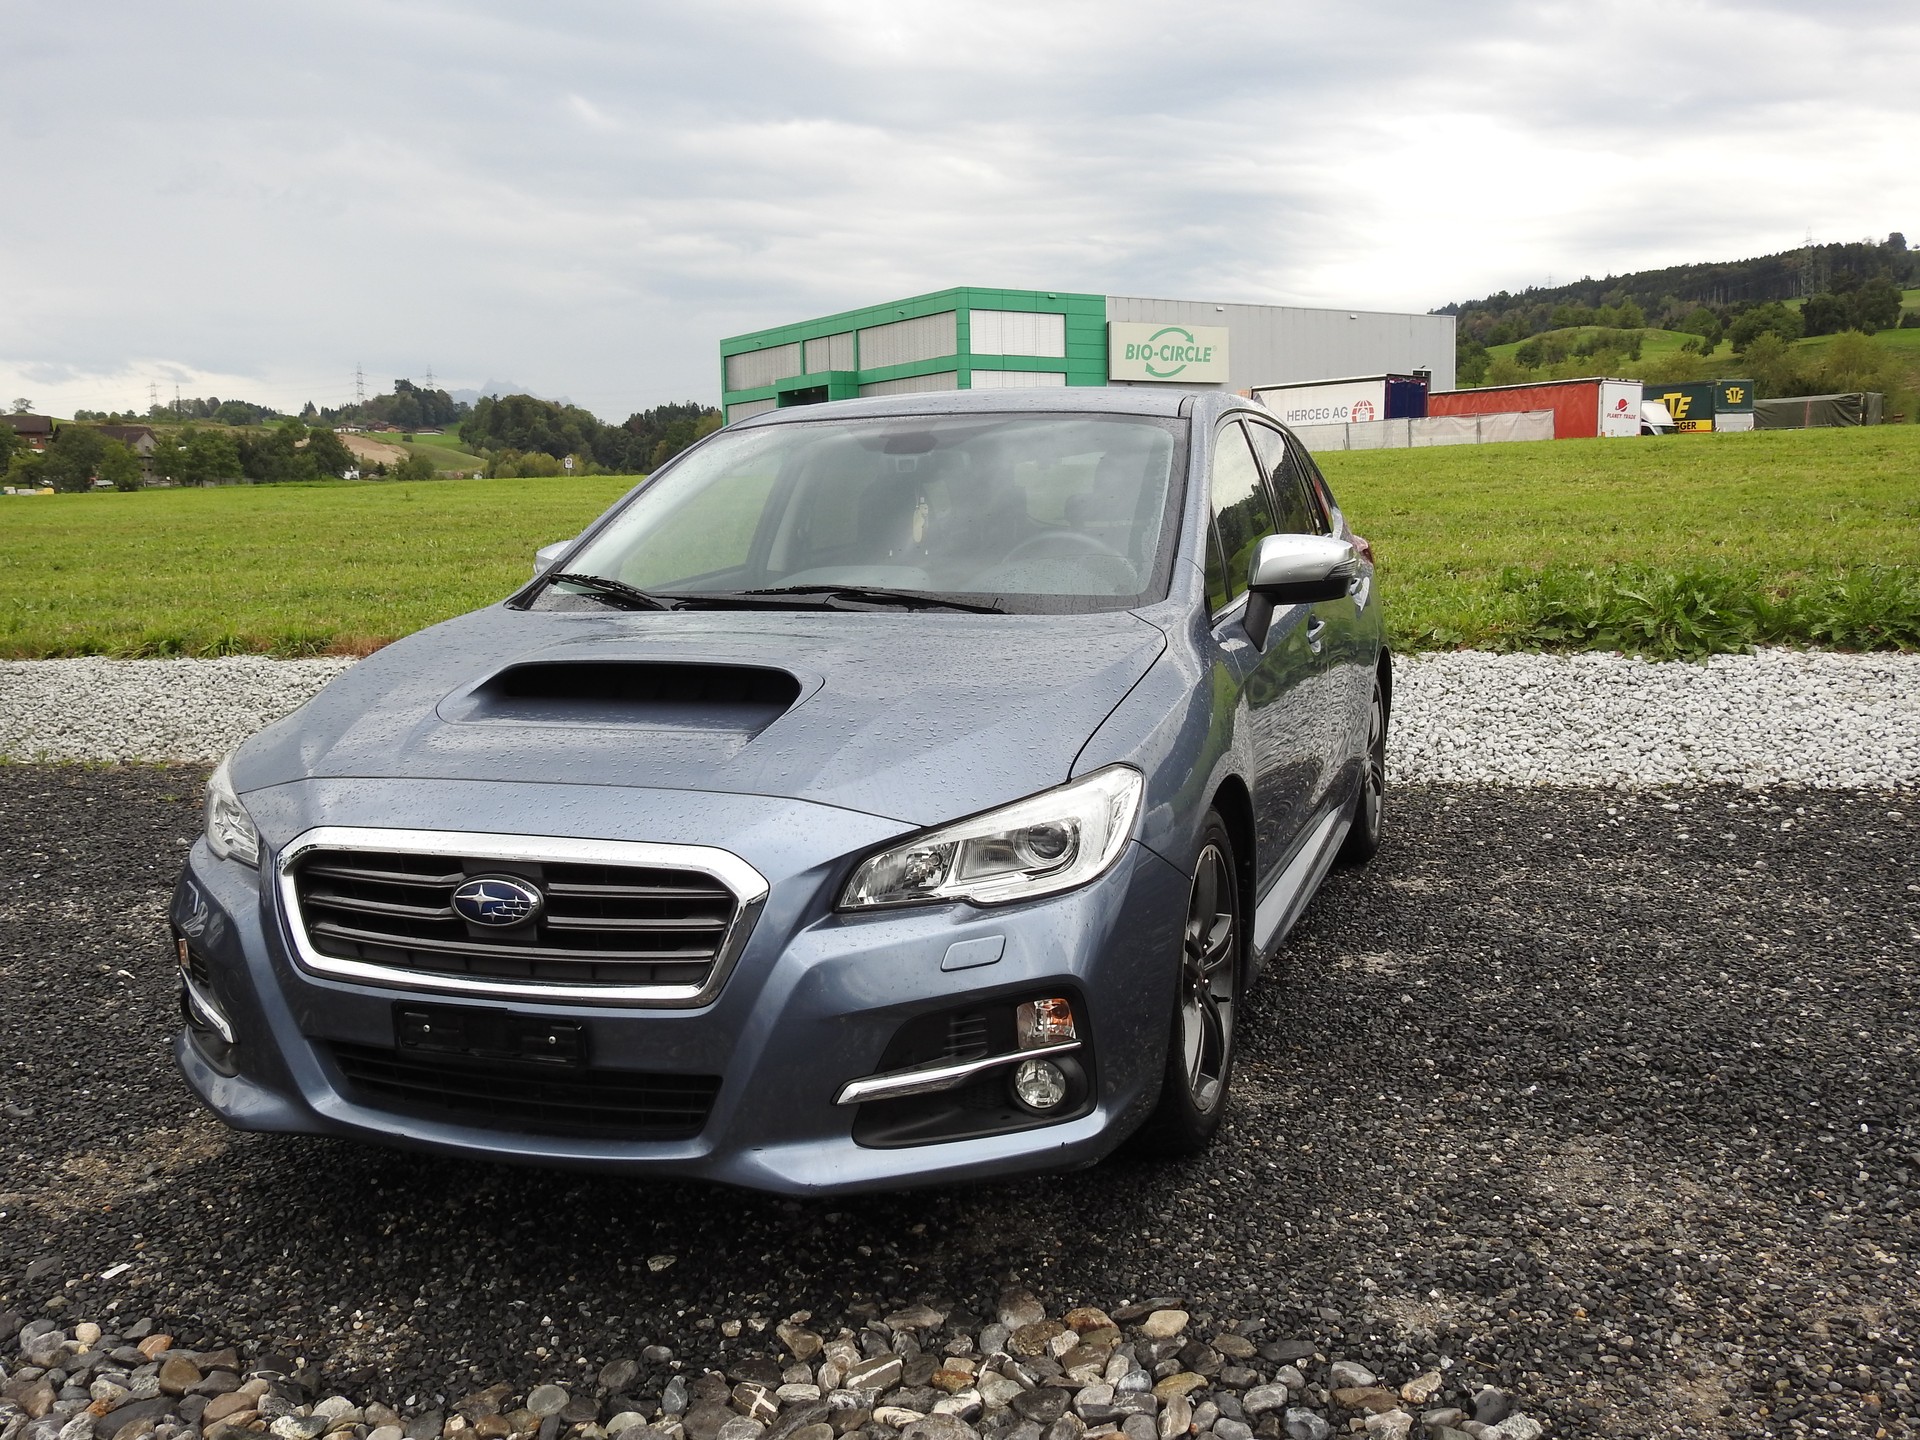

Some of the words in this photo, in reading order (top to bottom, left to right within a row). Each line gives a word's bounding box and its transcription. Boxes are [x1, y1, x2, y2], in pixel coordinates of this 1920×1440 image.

[1125, 343, 1212, 362] BIO-CIRCLE
[1287, 408, 1330, 421] HERCEG
[1332, 406, 1348, 419] AG
